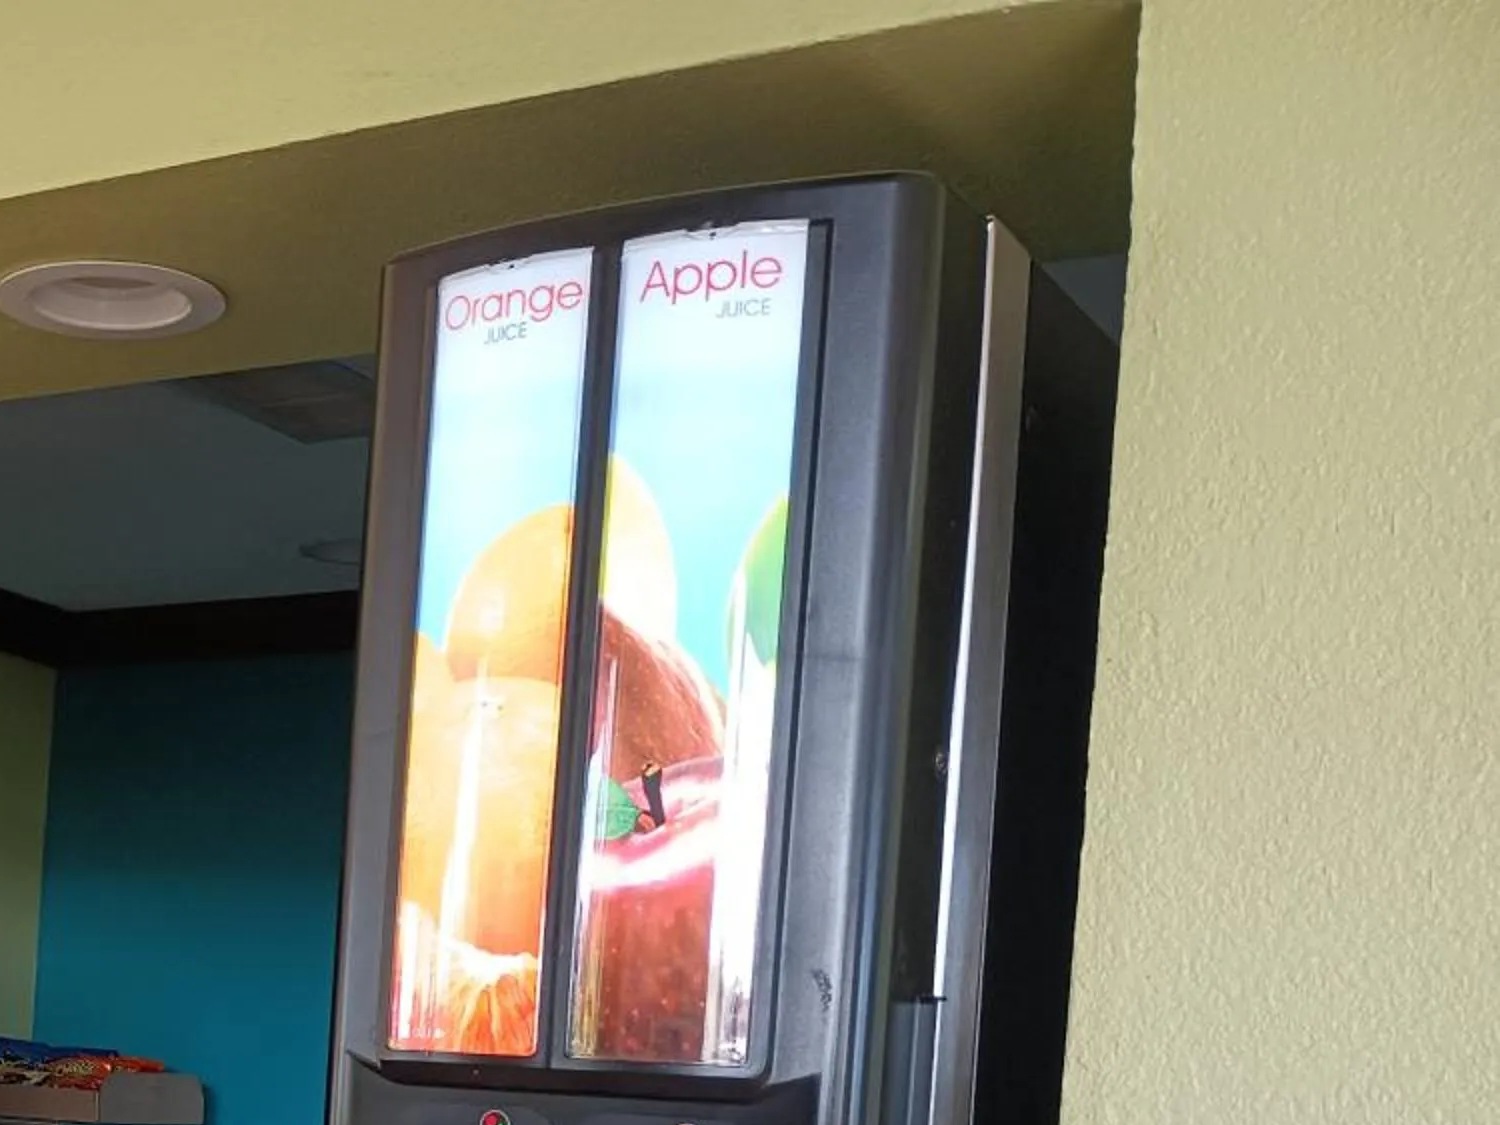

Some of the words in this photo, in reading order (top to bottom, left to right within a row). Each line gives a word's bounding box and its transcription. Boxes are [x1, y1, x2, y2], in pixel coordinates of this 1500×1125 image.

[639, 249, 783, 305] Apple
[445, 280, 584, 331] Orange
[715, 297, 771, 319] JUICE
[483, 321, 528, 345] JUICE
